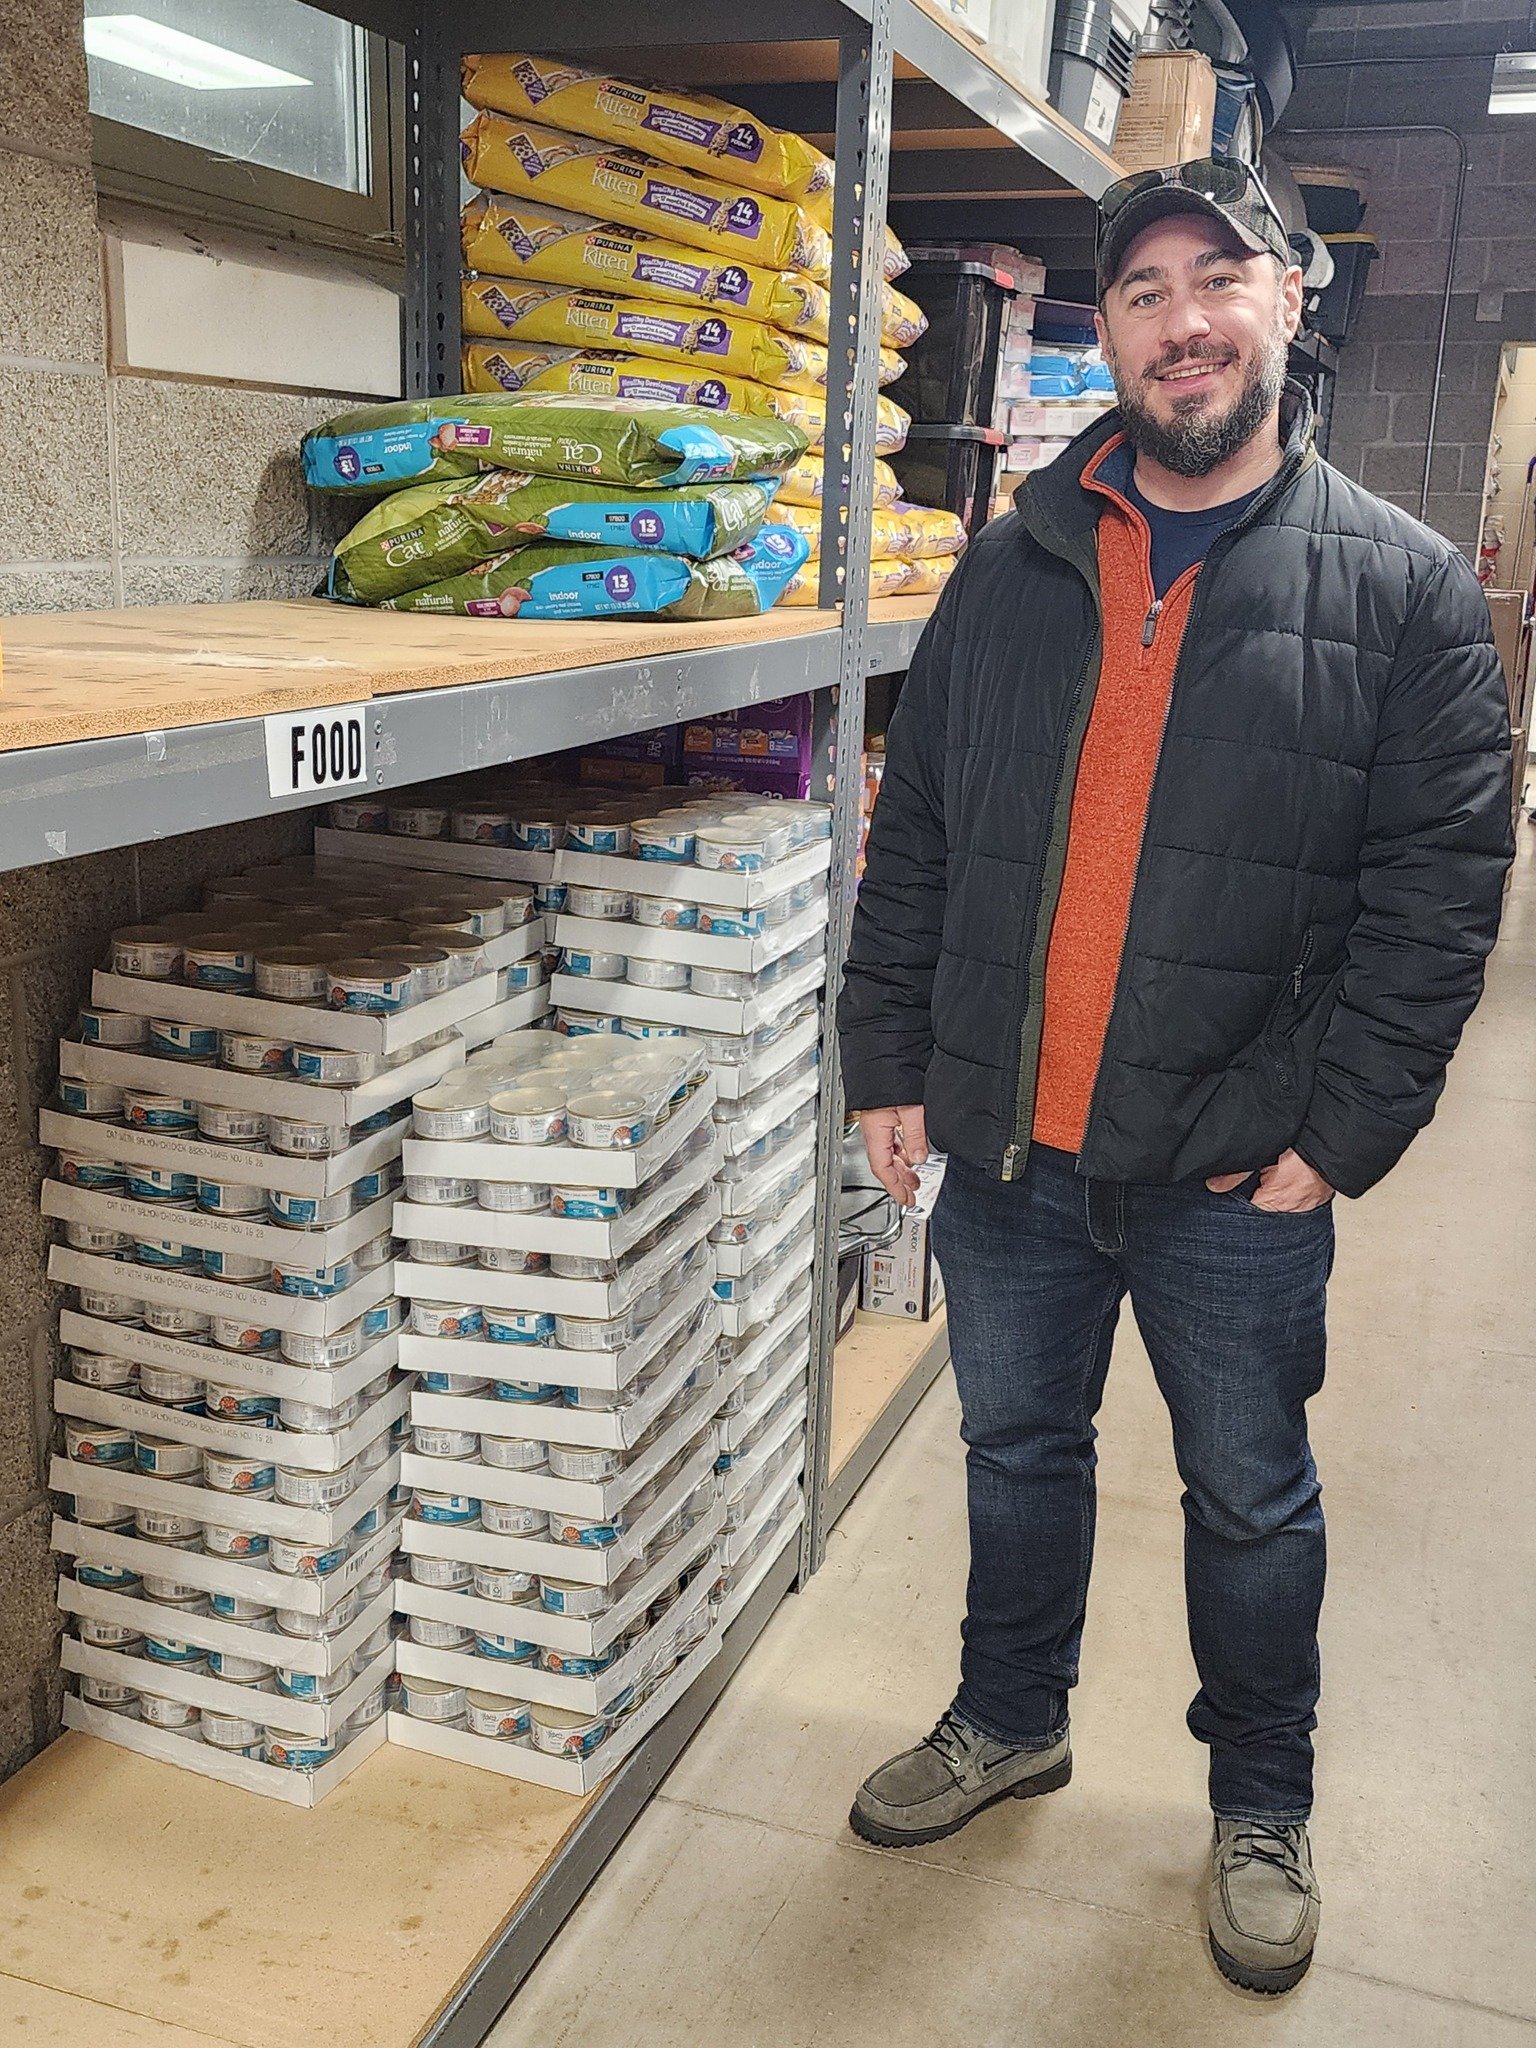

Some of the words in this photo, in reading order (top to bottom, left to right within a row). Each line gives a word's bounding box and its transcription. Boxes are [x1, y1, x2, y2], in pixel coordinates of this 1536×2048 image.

[609, 86, 644, 103] PURINA
[594, 92, 639, 120] Kitten
[651, 108, 675, 120] Healthy
[675, 112, 713, 132] Development
[730, 138, 752, 150] POUNDS
[736, 128, 753, 144] 14
[607, 162, 641, 178] PURINA
[592, 168, 638, 196] Kitten
[650, 185, 675, 196] Healthy
[675, 189, 712, 209] Development
[736, 202, 753, 219] 14
[730, 215, 752, 226] POUNDS
[596, 239, 631, 252] PURINA
[583, 246, 628, 271] Kitten
[640, 258, 664, 268] Healthy
[665, 260, 701, 278] Development
[725, 270, 742, 286] 14
[720, 282, 740, 293] POUNDS
[578, 300, 611, 311] PURINA
[565, 308, 609, 329] Kitten
[621, 316, 645, 325] Healthy
[645, 318, 680, 332] Development
[704, 322, 721, 336] 14
[579, 364, 612, 375] PURINA
[568, 372, 612, 393] Kitten
[622, 379, 645, 388] Healthy
[645, 380, 680, 394] Development
[704, 384, 720, 398] 14
[384, 442, 412, 454] Indoor
[502, 446, 543, 462] naturals
[563, 444, 603, 466] Cat
[340, 459, 355, 474] 13
[559, 463, 593, 474] PURINA
[638, 519, 657, 533] 13
[389, 528, 424, 547] PURINA
[568, 529, 601, 540] Indoor
[386, 540, 426, 567] Cat
[612, 574, 629, 589] 13
[415, 593, 454, 606] naturals
[549, 592, 578, 601] Indoor
[379, 599, 398, 611] at
[291, 719, 362, 789] FOOD
[769, 741, 775, 751] 8
[119, 1132, 135, 1144] WITH
[136, 1136, 158, 1147] SALMON
[160, 1140, 187, 1153] CHICKEN
[230, 1154, 242, 1163] NOV
[119, 1202, 135, 1213] WITH
[137, 1207, 158, 1218] SALMON
[161, 1211, 187, 1224] CHICKEN
[231, 1225, 243, 1234] NOV
[128, 1268, 142, 1280] WITH
[144, 1274, 165, 1285] SALMON
[167, 1278, 192, 1290] CHICKEN
[235, 1292, 246, 1301] NOV
[137, 1336, 150, 1346] WITH
[153, 1340, 173, 1352] SALMON
[175, 1345, 200, 1358] CHICKEN
[242, 1360, 254, 1370] NOV
[134, 1406, 149, 1417] WITH
[151, 1411, 171, 1423] SALMON
[173, 1415, 198, 1428] CHICKEN
[240, 1431, 251, 1440] NOV
